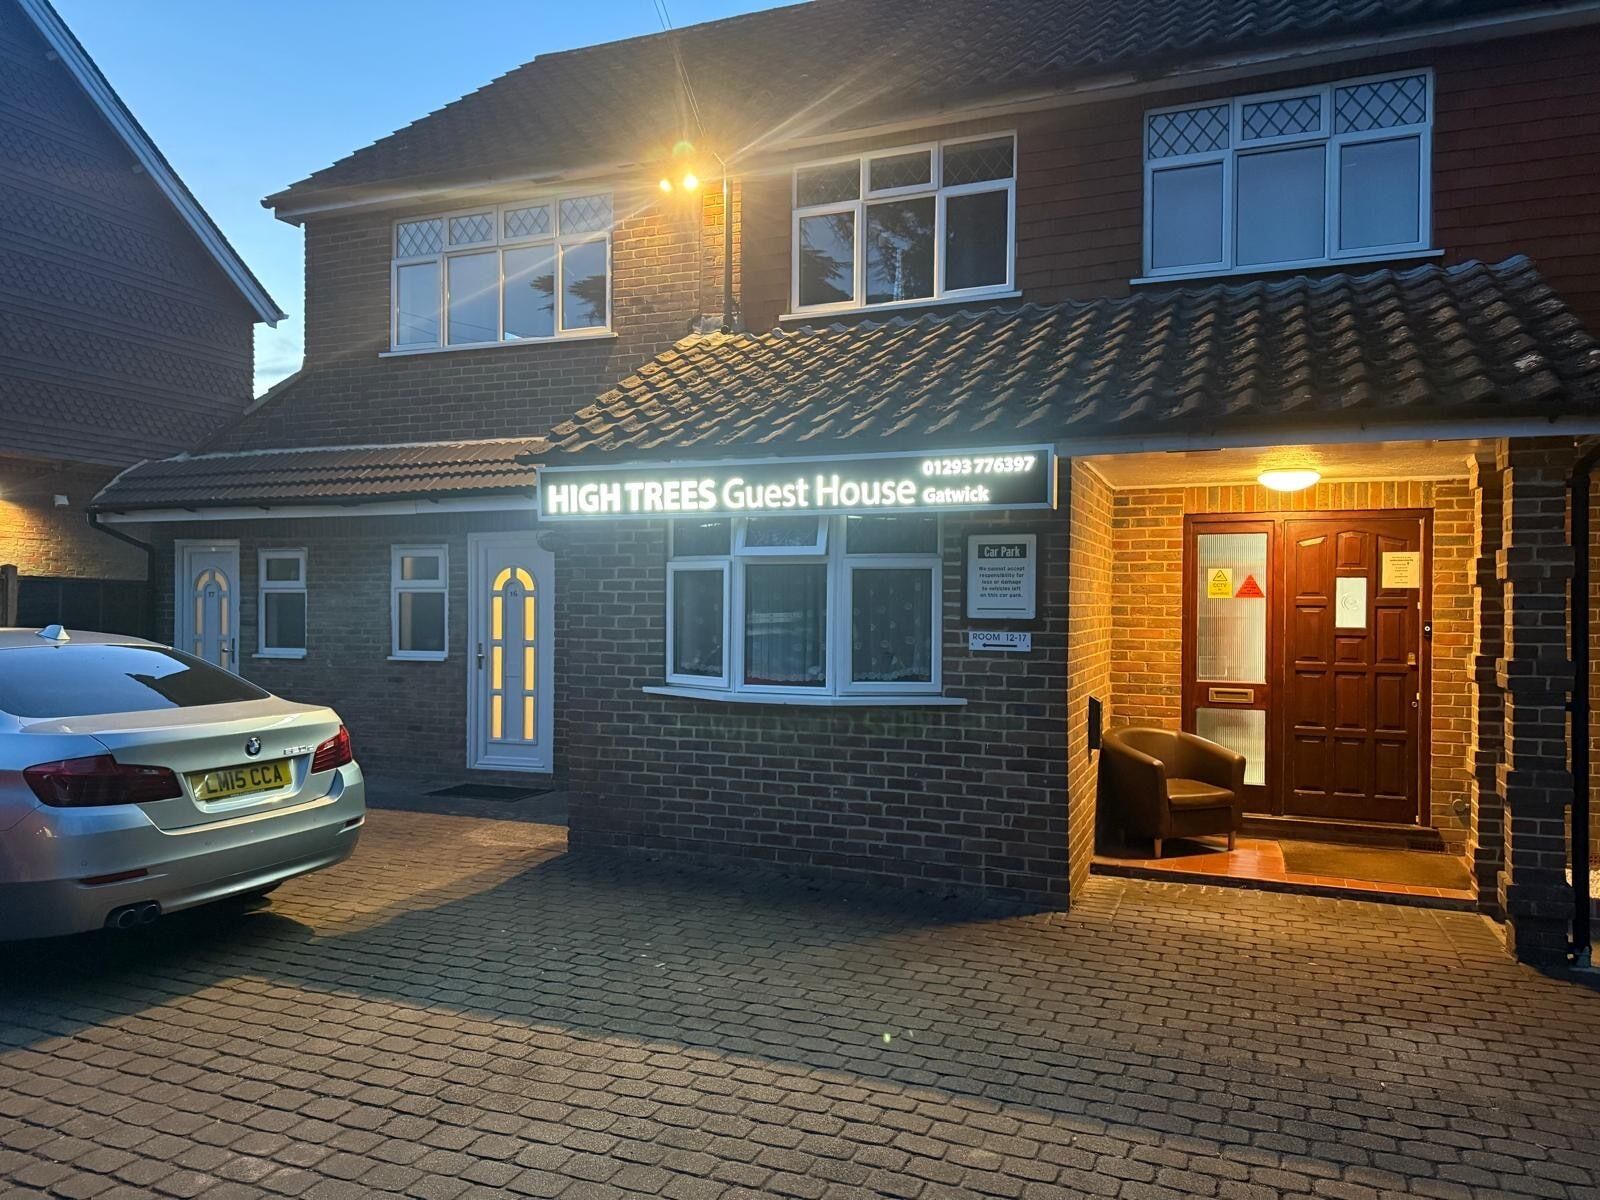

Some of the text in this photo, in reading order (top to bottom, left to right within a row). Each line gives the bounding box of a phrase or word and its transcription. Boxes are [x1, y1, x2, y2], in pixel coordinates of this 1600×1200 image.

[922, 456, 1036, 476] 01293 776397
[548, 474, 917, 513] HIGH TREES Guest House
[922, 485, 991, 503] Gatwick
[984, 546, 1020, 557] Car Park
[972, 633, 1027, 642] ROOM 12-17
[204, 770, 247, 794] LM15
[251, 765, 283, 787] CCA
